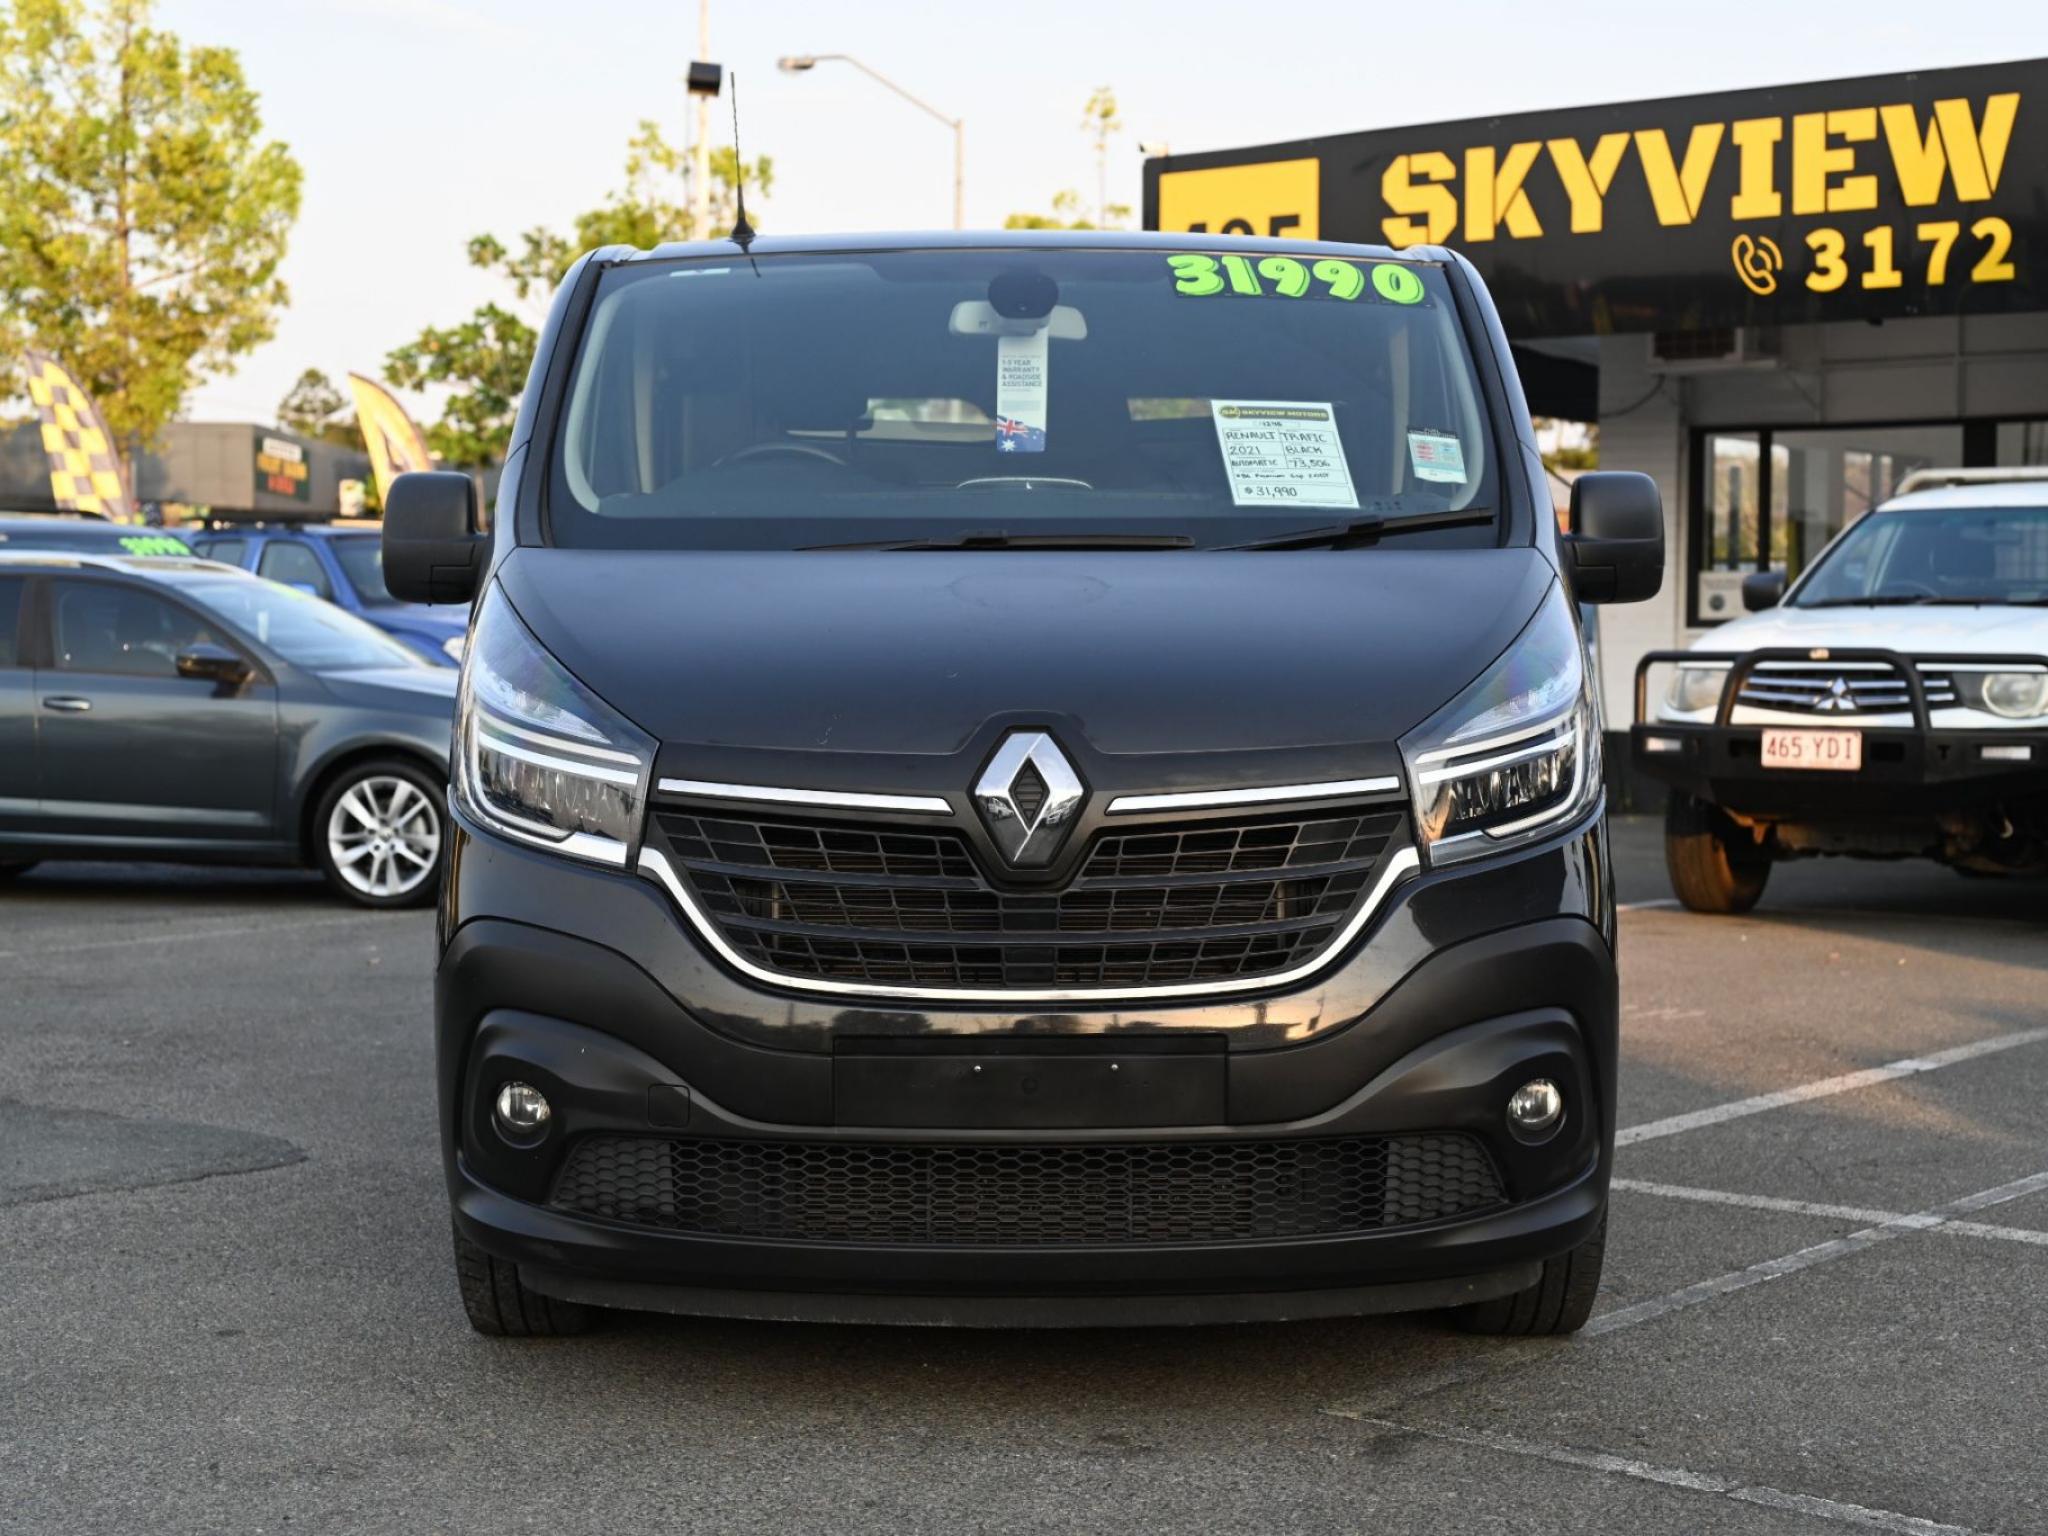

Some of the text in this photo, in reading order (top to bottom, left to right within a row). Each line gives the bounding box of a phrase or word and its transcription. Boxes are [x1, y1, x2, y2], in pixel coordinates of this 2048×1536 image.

[1381, 93, 2021, 248] SKYVIEW
[1805, 217, 2016, 293] 3172
[1166, 254, 1425, 305] 31990
[1225, 431, 1276, 441] RENAULT
[1281, 432, 1328, 443] TRAFIC
[1229, 445, 1261, 456] 2021
[1285, 445, 1323, 455] BLACK
[1766, 736, 1853, 759] 465 YDI
